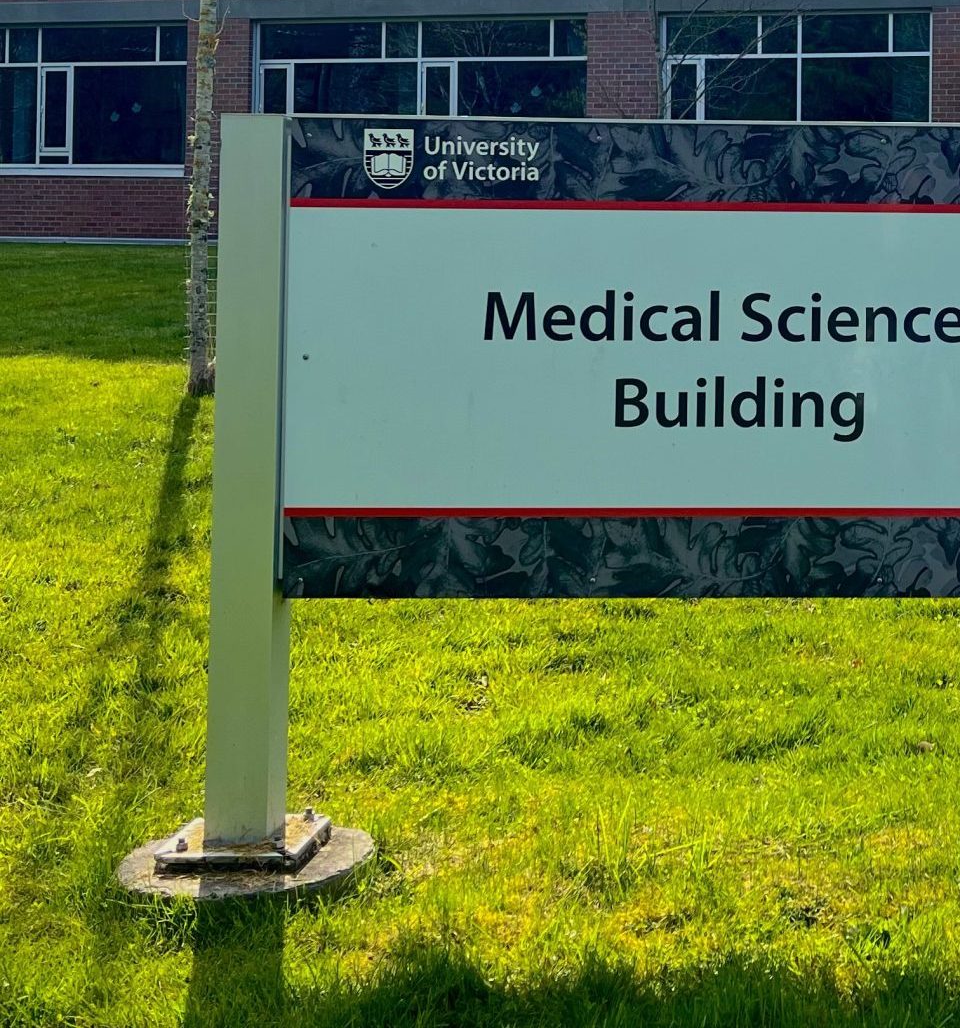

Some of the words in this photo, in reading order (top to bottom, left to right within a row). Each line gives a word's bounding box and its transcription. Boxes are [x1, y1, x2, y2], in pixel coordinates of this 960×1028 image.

[424, 135, 541, 162] University
[422, 160, 448, 181] of
[451, 161, 540, 181] Victoria
[483, 289, 721, 343] Medical
[614, 375, 866, 443] Building
